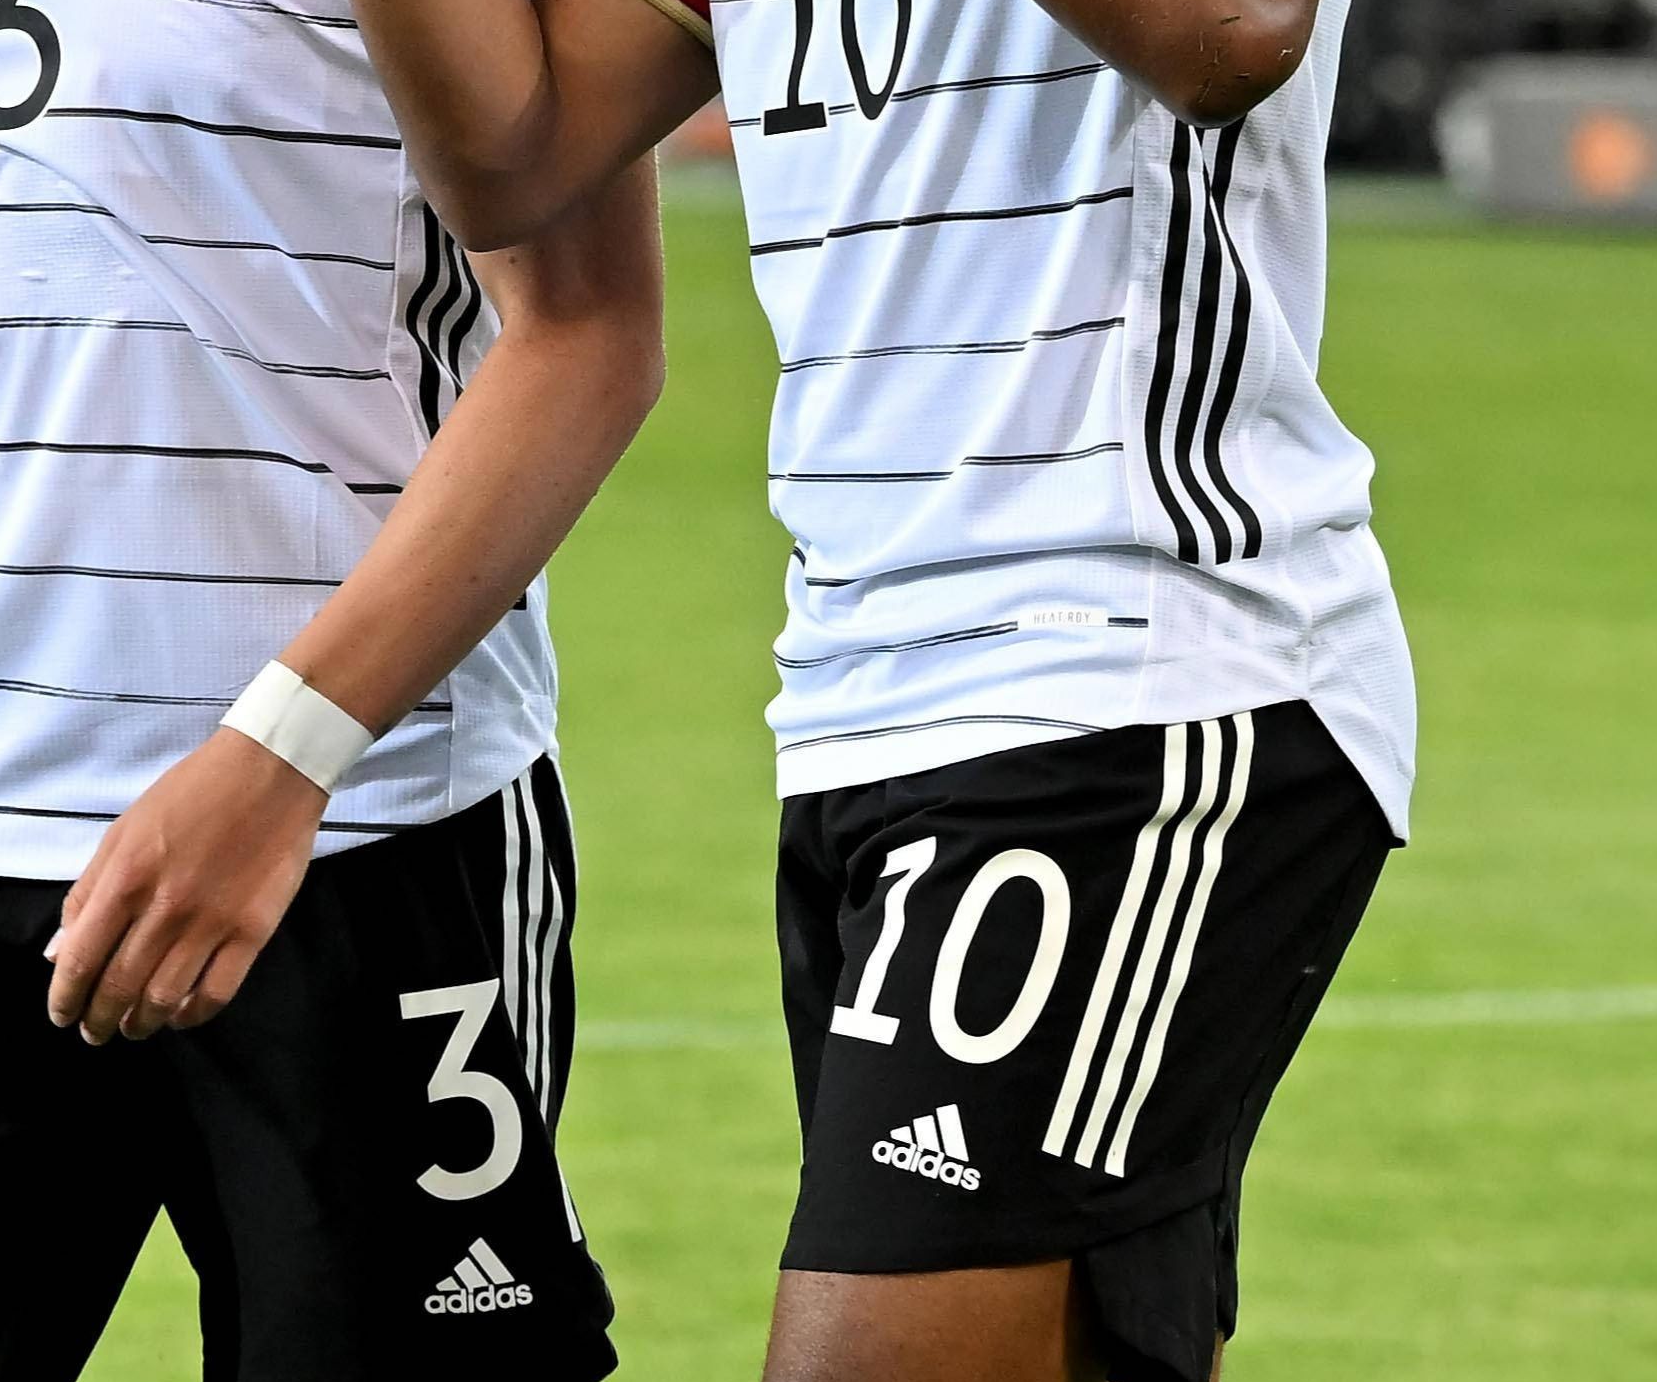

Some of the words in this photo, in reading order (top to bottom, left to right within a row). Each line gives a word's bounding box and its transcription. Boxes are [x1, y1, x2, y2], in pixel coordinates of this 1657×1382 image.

[829, 835, 1071, 1064] 10
[398, 977, 523, 1201] 3
[872, 1140, 981, 1191] adidas
[425, 1284, 534, 1314] adidas
